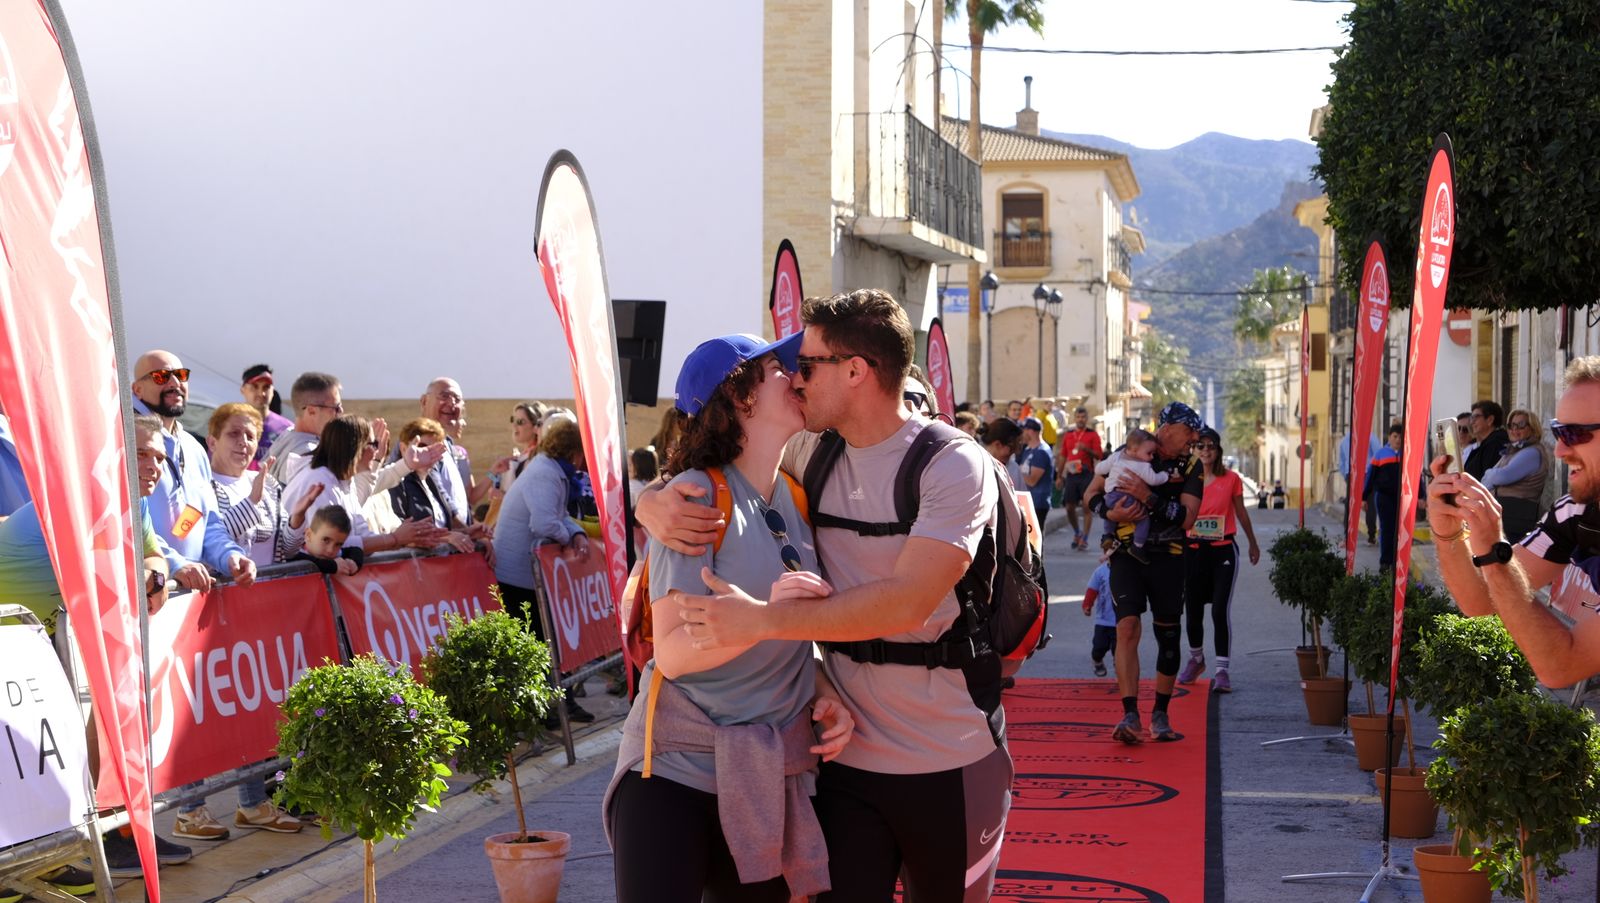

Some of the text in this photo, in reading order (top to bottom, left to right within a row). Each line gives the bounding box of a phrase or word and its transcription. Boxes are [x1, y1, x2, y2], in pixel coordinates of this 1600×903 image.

[175, 631, 308, 725] VEOLIA
[5, 677, 44, 708] DE
[1002, 838, 1129, 847] Ayunta
[1070, 885, 1121, 893] LA
